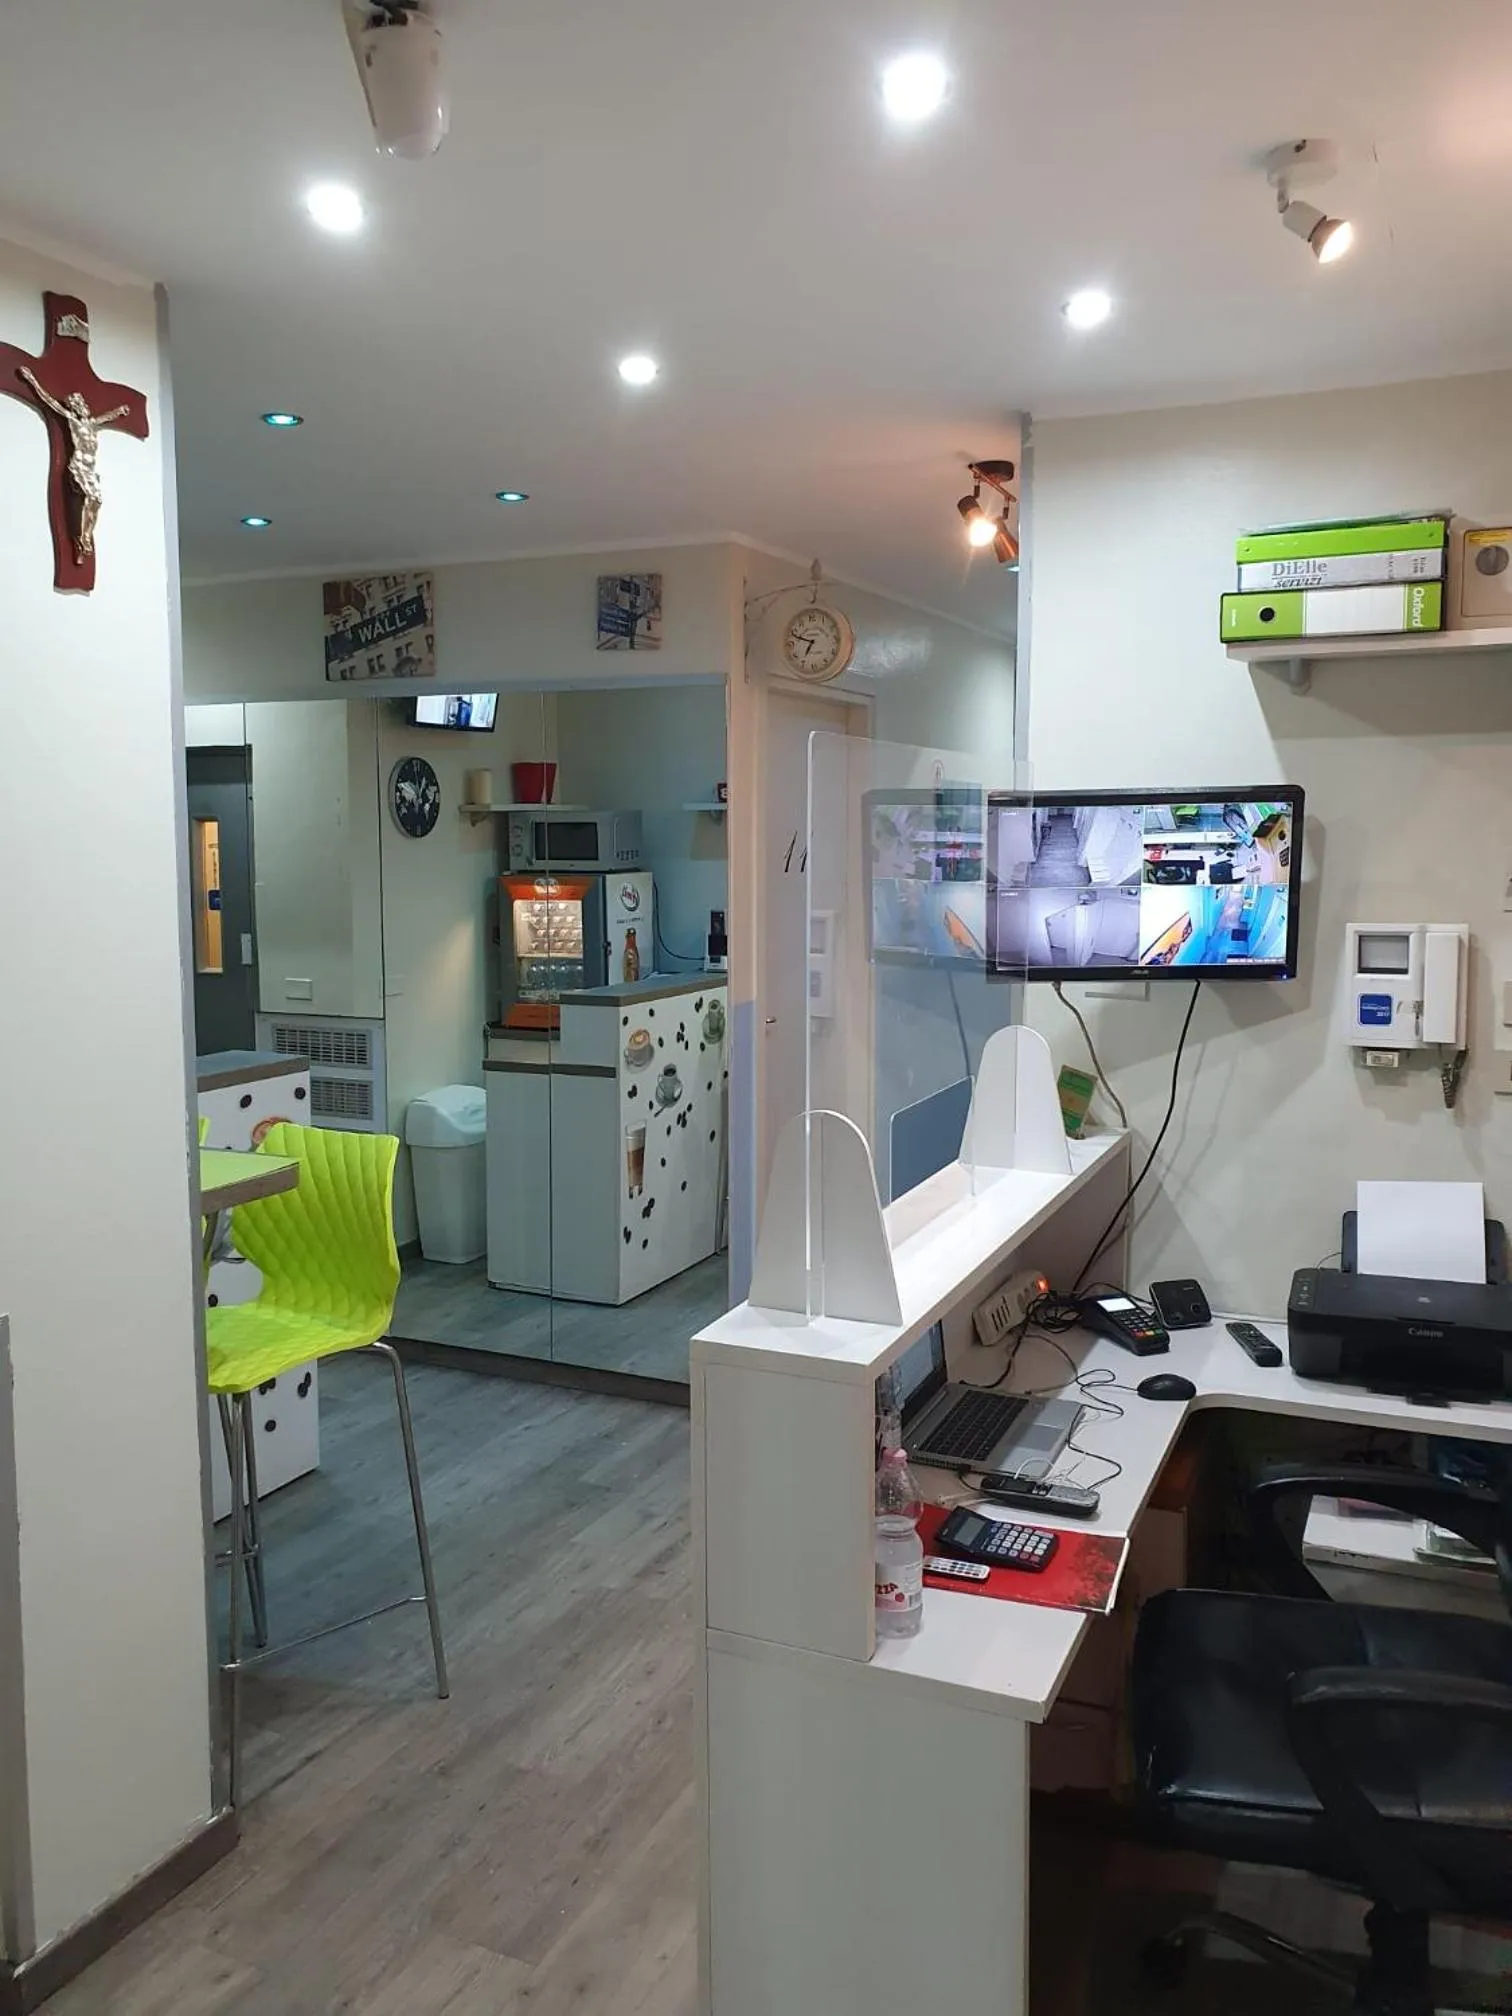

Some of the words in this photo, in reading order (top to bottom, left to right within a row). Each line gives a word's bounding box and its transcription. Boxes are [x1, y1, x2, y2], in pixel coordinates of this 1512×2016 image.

[1272, 560, 1328, 576] DiElle
[358, 612, 408, 643] WALL
[405, 603, 417, 617] ST
[1413, 587, 1425, 628] Oxford
